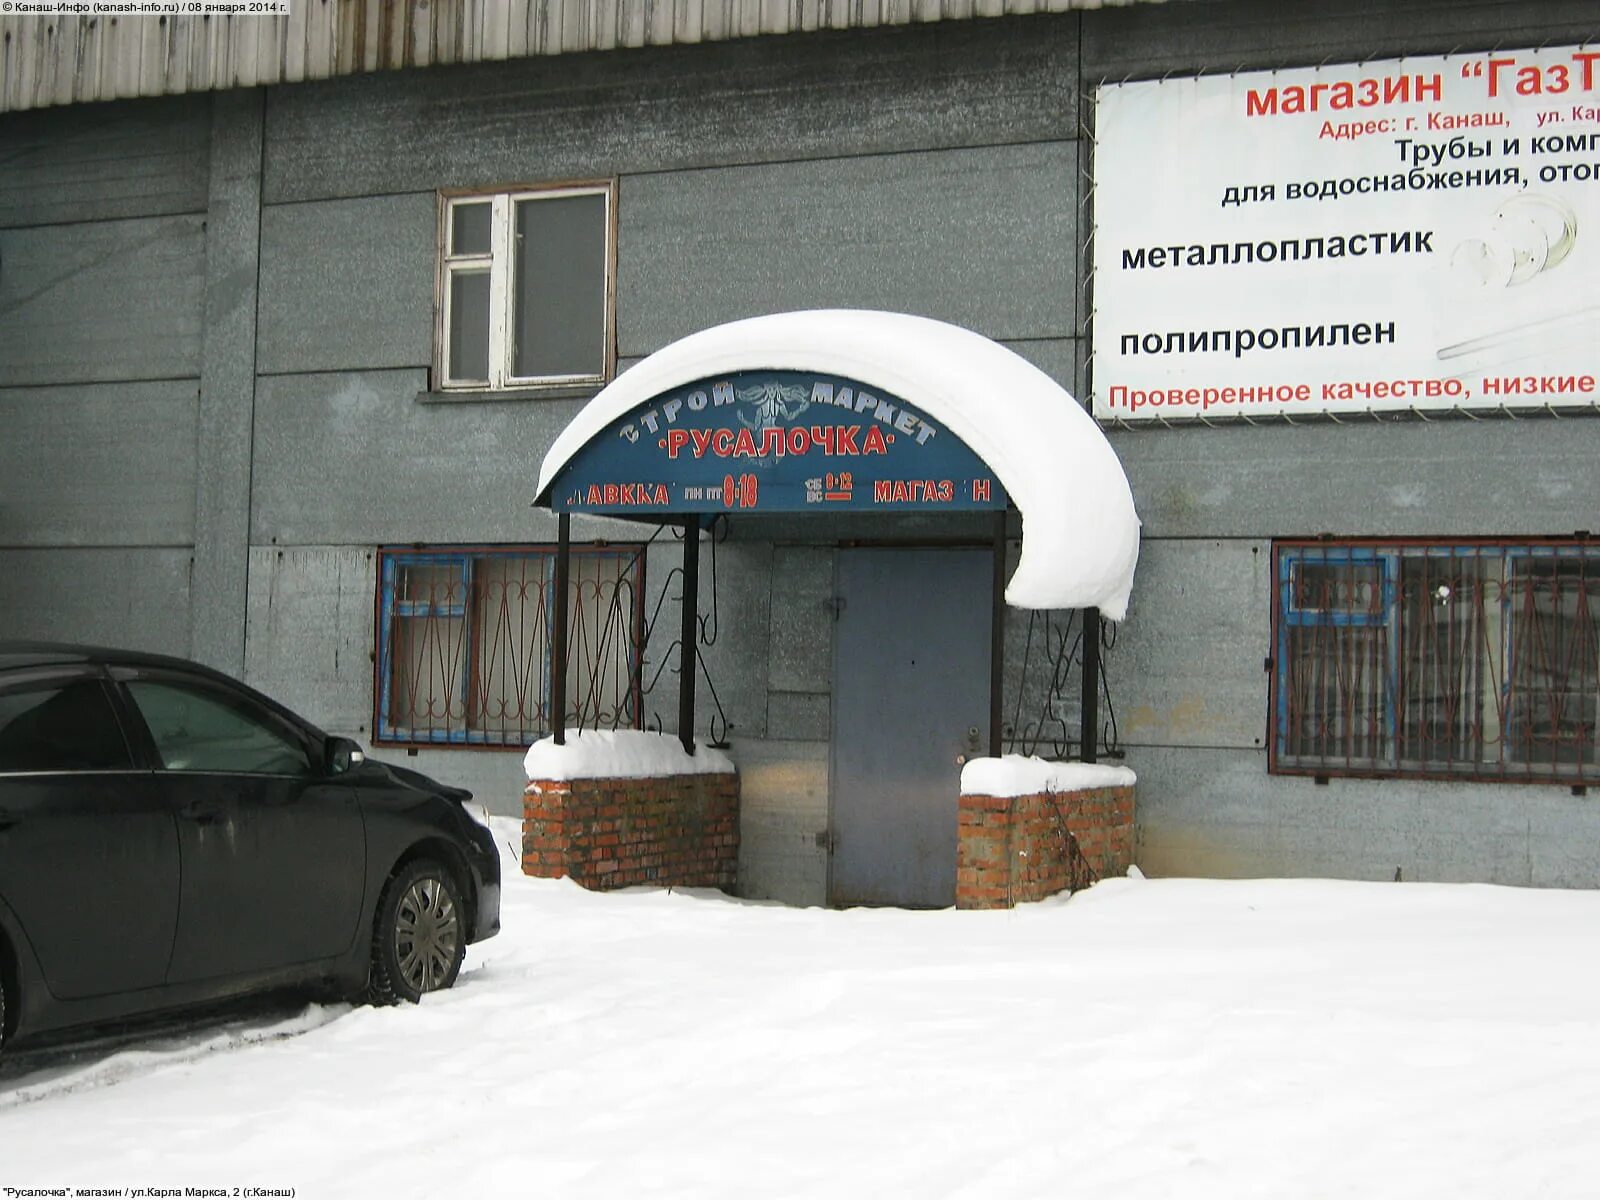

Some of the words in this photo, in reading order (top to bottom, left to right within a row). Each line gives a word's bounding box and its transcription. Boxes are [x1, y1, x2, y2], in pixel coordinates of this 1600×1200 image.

[1246, 73, 1442, 117] магазин
[1319, 116, 1397, 140] Адрес:
[1405, 115, 1419, 132] г.
[1427, 111, 1510, 131] Канаш,
[1537, 111, 1565, 127] ул.
[1395, 136, 1492, 166] Трубы
[1503, 137, 1520, 155] и
[1221, 182, 1276, 207] для
[1286, 166, 1529, 200] водоснабжения,
[1122, 230, 1433, 270] металлопластик
[1120, 320, 1396, 358] полипропилен
[1108, 382, 1311, 412] Проверенное
[1321, 378, 1471, 401] качество,
[1482, 374, 1596, 395] низкие
[618, 381, 735, 444] СТРОЙ
[810, 382, 937, 446] МАРКЕТ
[667, 425, 888, 459] РУСАЛОЧКА
[874, 479, 991, 504] МАГАЗН
